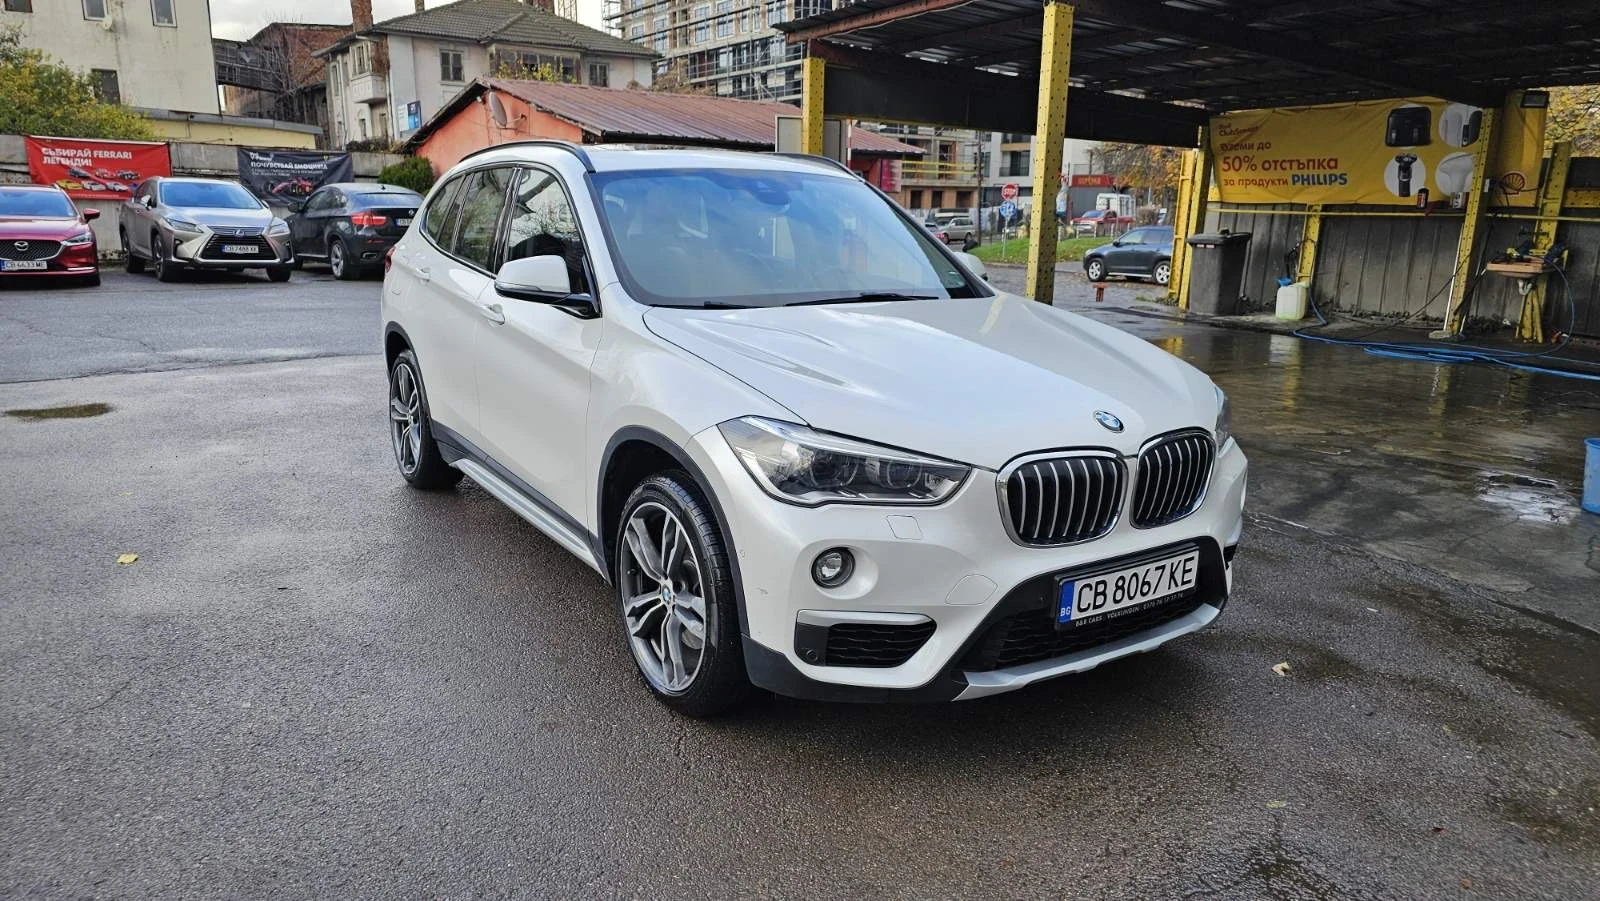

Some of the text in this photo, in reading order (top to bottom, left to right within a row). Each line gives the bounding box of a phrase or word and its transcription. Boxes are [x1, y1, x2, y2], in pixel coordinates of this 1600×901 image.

[41, 147, 132, 159] СЪБИРАЙ FERRARI
[1257, 142, 1272, 151] до
[1222, 155, 1339, 172] 50% отстъпка
[1223, 172, 1348, 189] за продукти PHILIPS
[1077, 579, 1108, 613] CB
[1112, 564, 1166, 604] 8067
[1168, 556, 1195, 590] KE
[1060, 606, 1071, 616] BG
